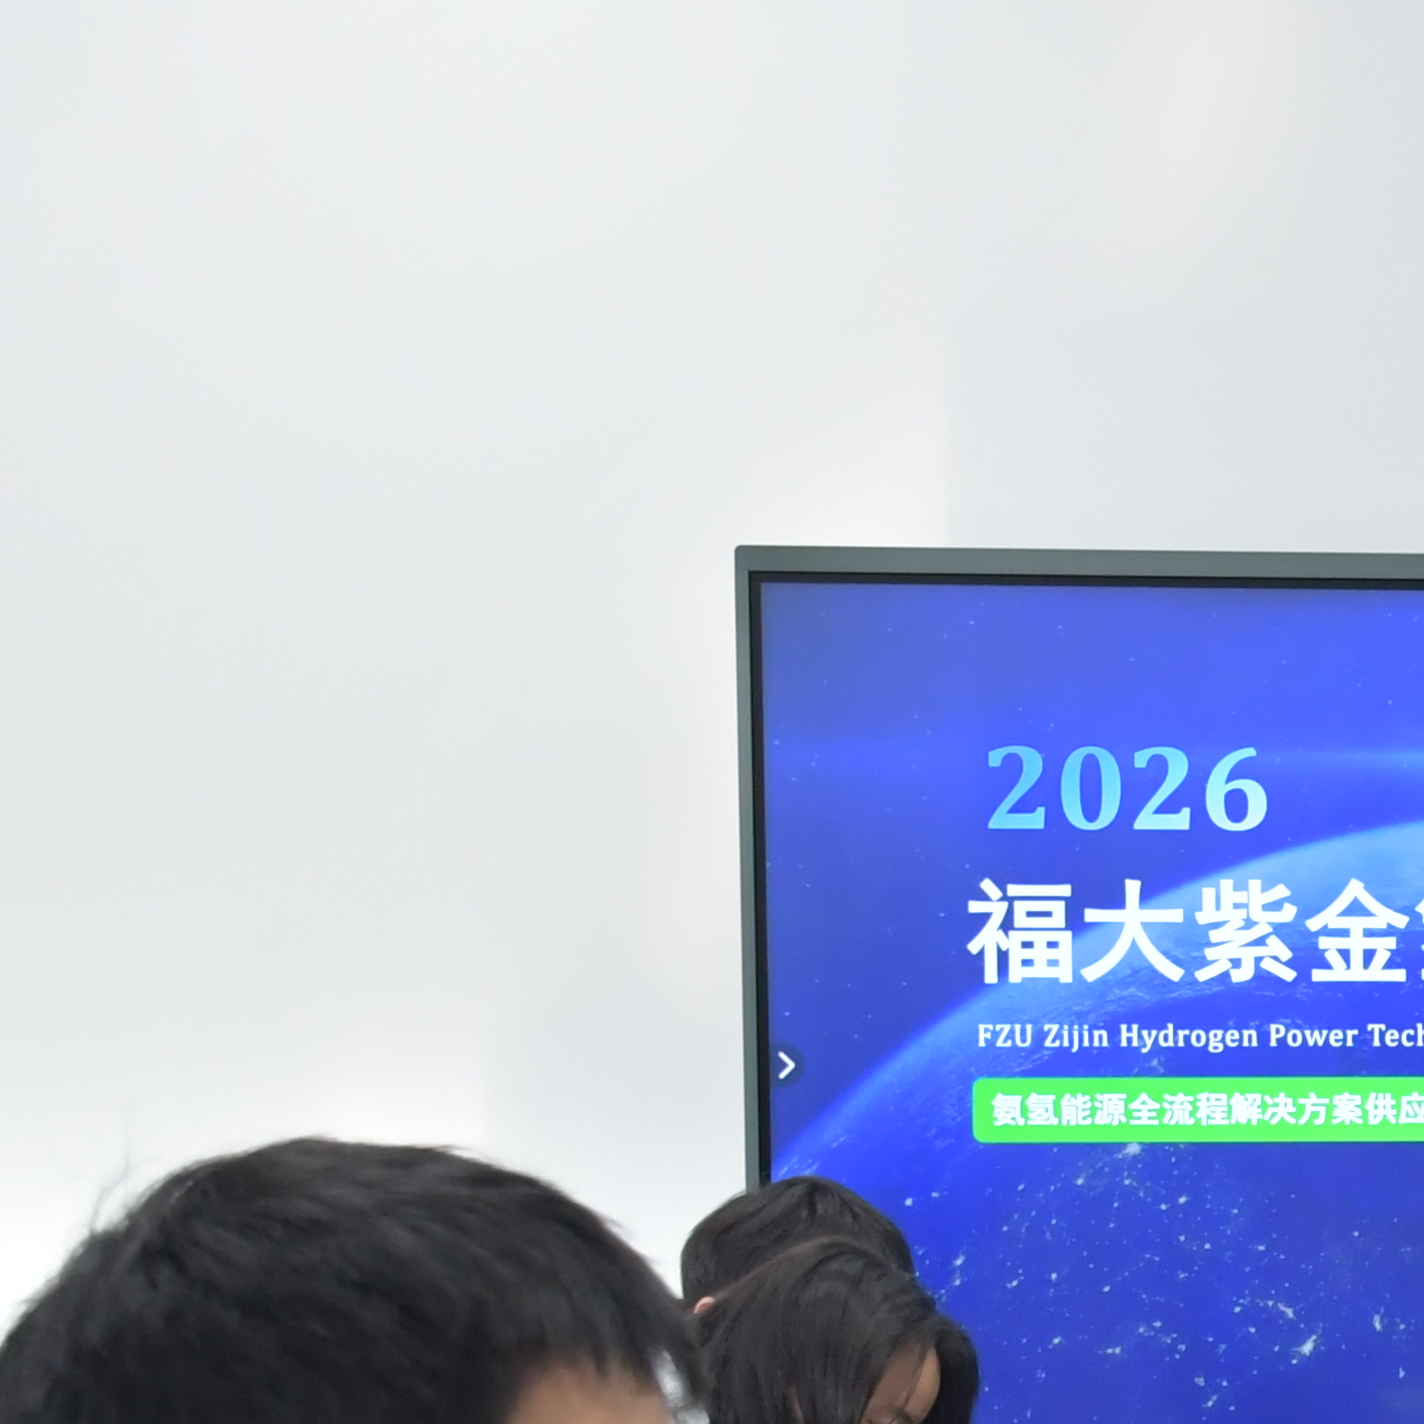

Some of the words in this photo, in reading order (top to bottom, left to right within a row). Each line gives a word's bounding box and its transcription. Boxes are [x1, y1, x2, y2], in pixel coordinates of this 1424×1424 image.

[986, 744, 1268, 831] 2026
[977, 1024, 1033, 1048] FZU
[1043, 1023, 1109, 1053] Zijin
[1119, 1023, 1258, 1054] Hydrogen
[1269, 1024, 1359, 1047] Power
